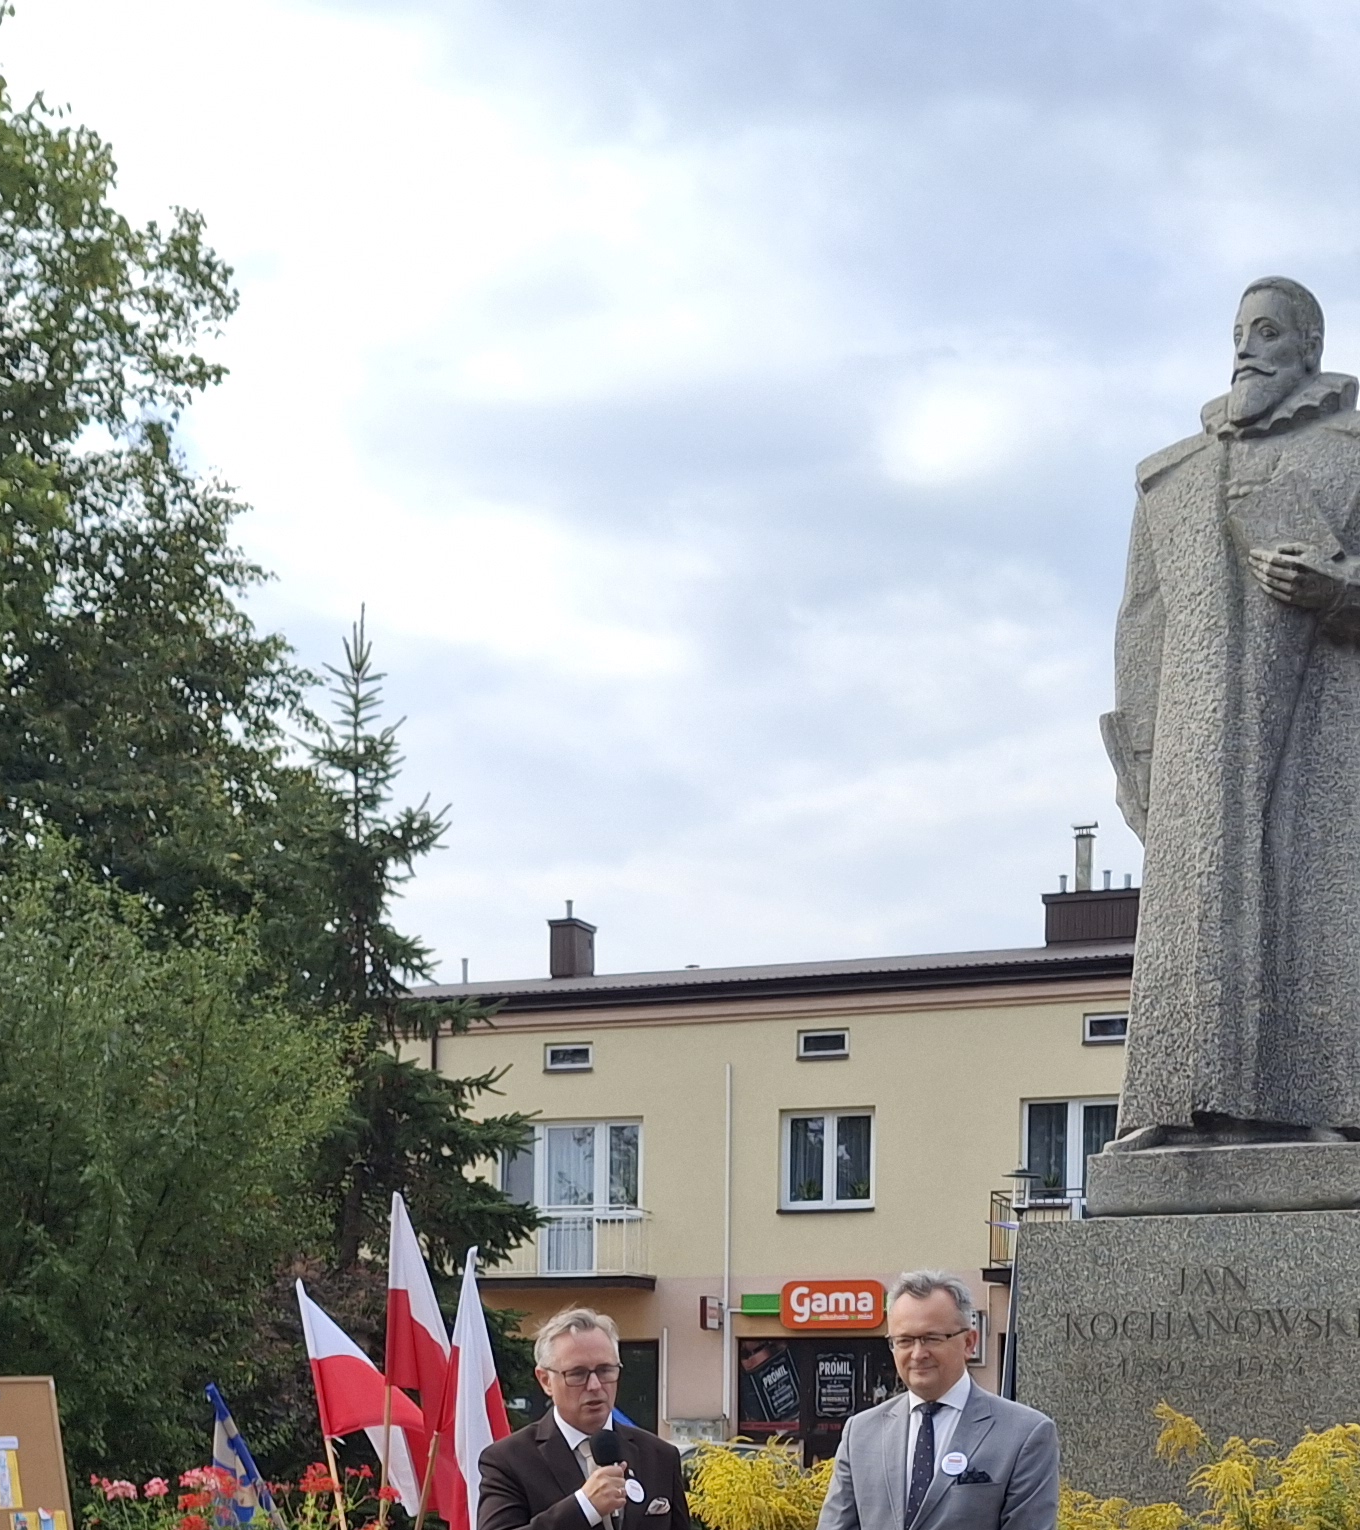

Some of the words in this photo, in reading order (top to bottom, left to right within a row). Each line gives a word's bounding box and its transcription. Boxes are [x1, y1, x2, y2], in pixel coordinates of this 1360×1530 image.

[1176, 1266, 1248, 1297] JAN
[762, 1364, 788, 1389] PROMIL
[818, 1361, 852, 1376] PROMIL
